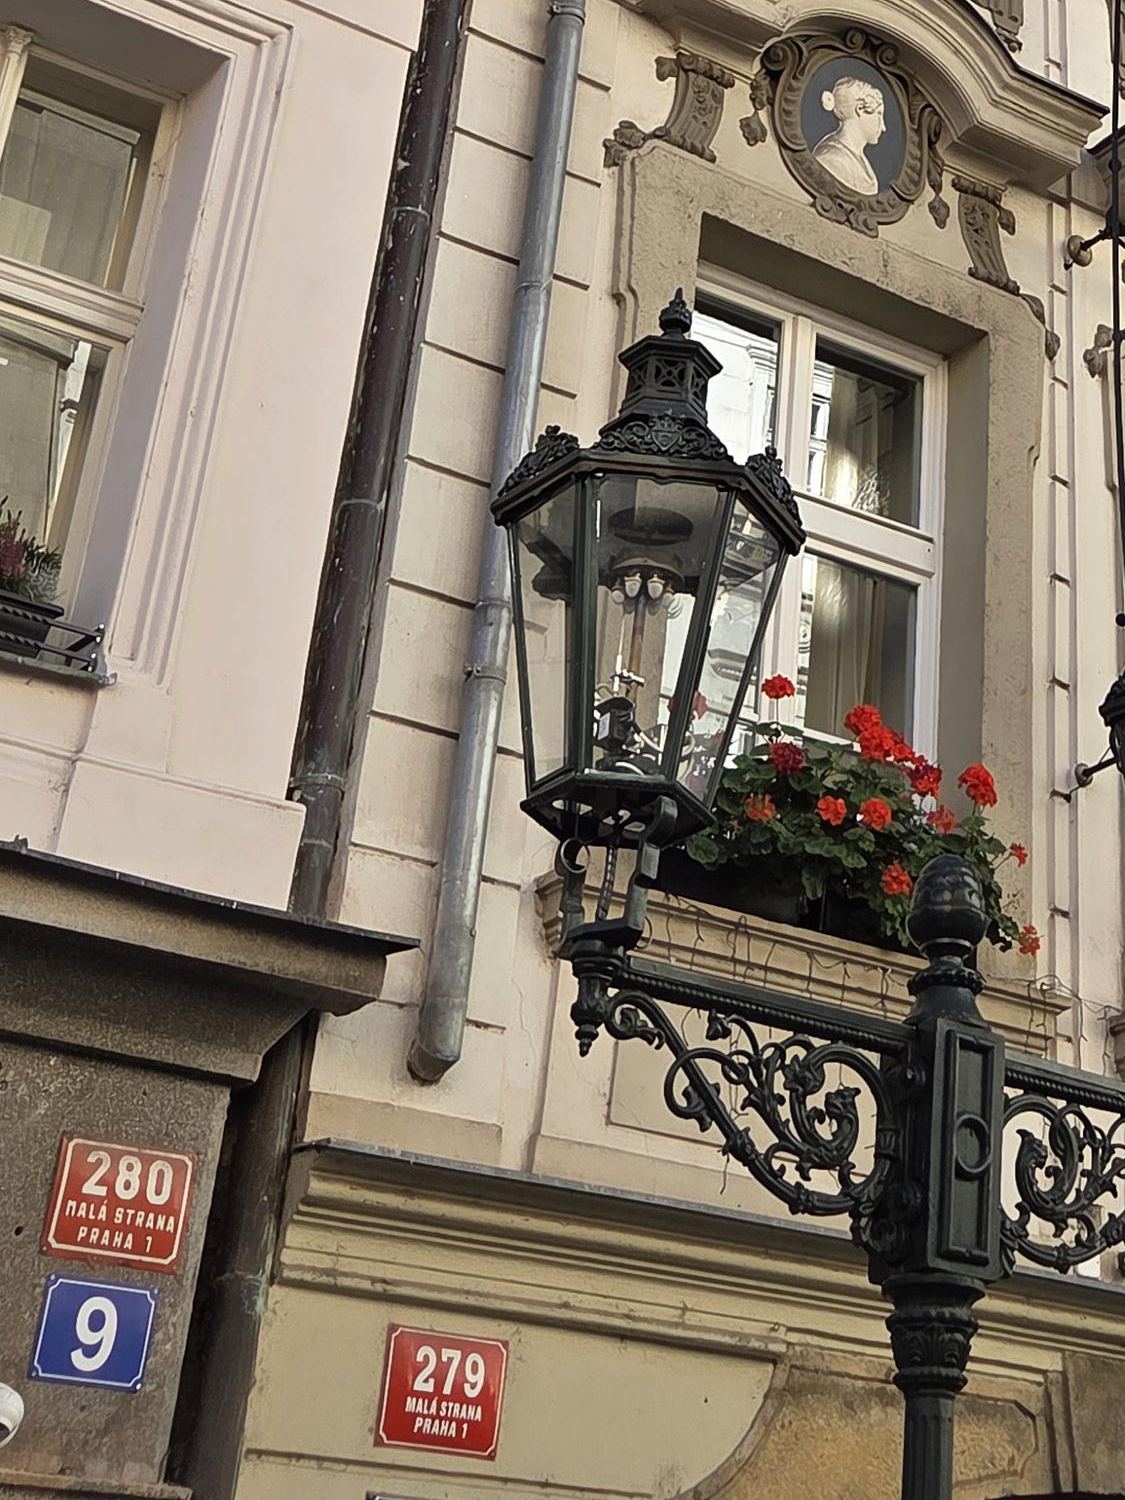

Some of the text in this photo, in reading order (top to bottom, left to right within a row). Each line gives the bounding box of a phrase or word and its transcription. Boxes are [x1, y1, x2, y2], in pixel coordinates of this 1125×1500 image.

[81, 1150, 174, 1206] 280
[64, 1199, 176, 1234] MALÁ STRANA
[76, 1225, 153, 1254] PRAHA 1
[70, 1296, 118, 1372] 9
[412, 1345, 486, 1399] 279
[404, 1396, 483, 1422] MALÁ STRANA
[413, 1416, 468, 1440] PRAHA 1
